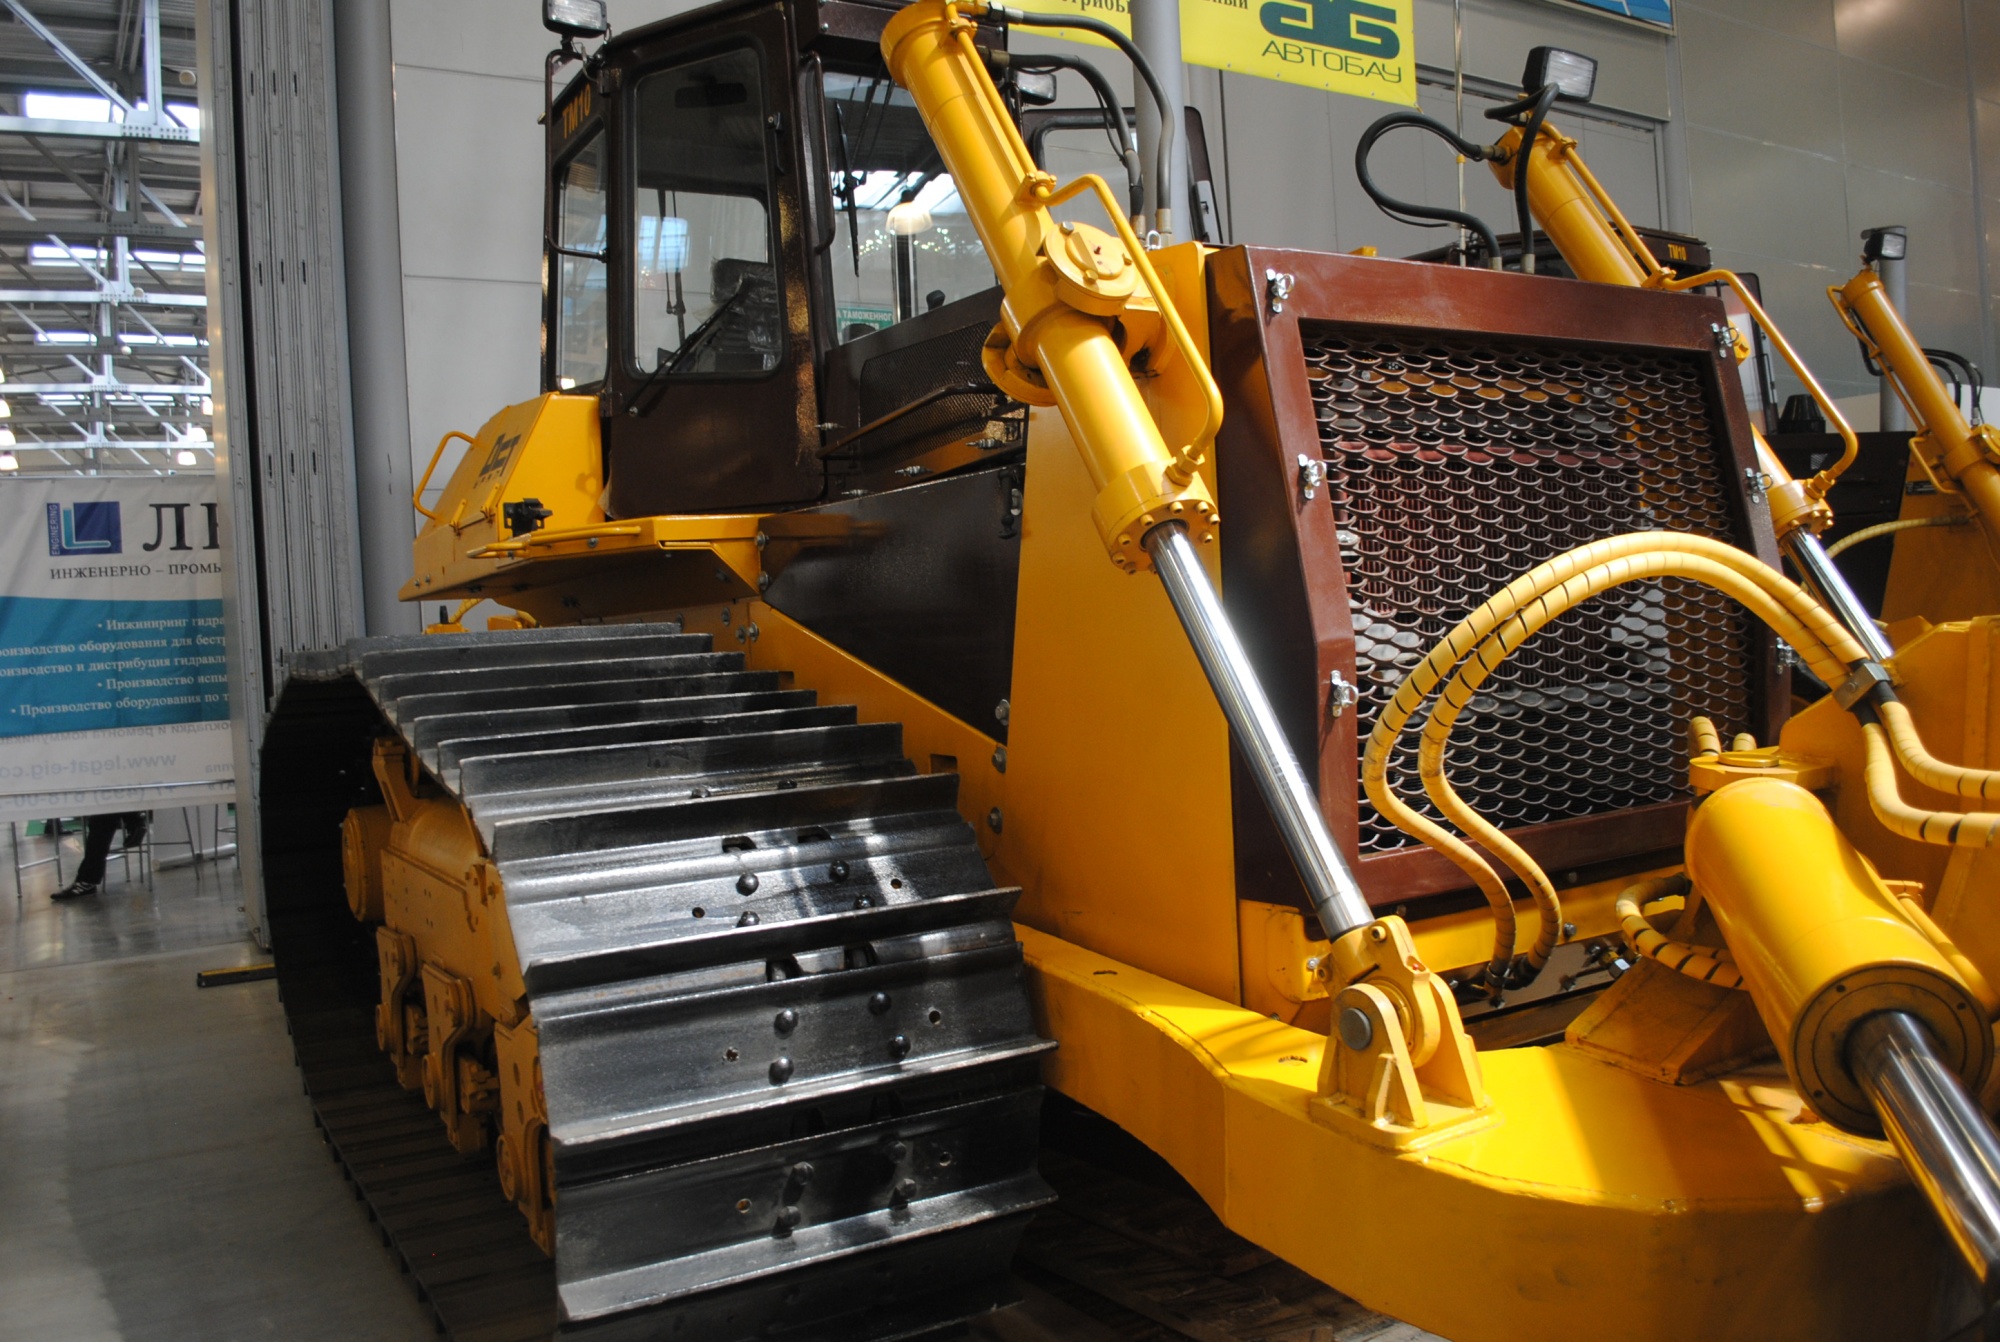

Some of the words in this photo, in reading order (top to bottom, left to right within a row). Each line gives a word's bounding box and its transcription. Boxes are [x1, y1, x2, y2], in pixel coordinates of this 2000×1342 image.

[1261, 40, 1402, 83] АВТОБАУ
[842, 310, 894, 322] ТАМОЖЕННОГ
[51, 565, 151, 580] ИНЖЕНЕРНО
[0, 644, 76, 658] оизводство
[79, 637, 168, 653] оборудования
[171, 637, 193, 648] для
[77, 664, 85, 672] и
[88, 657, 170, 673] дистрибуция
[106, 674, 194, 690] Производство
[20, 699, 112, 717] Производство
[115, 693, 201, 711] оборудования
[204, 692, 220, 704] по
